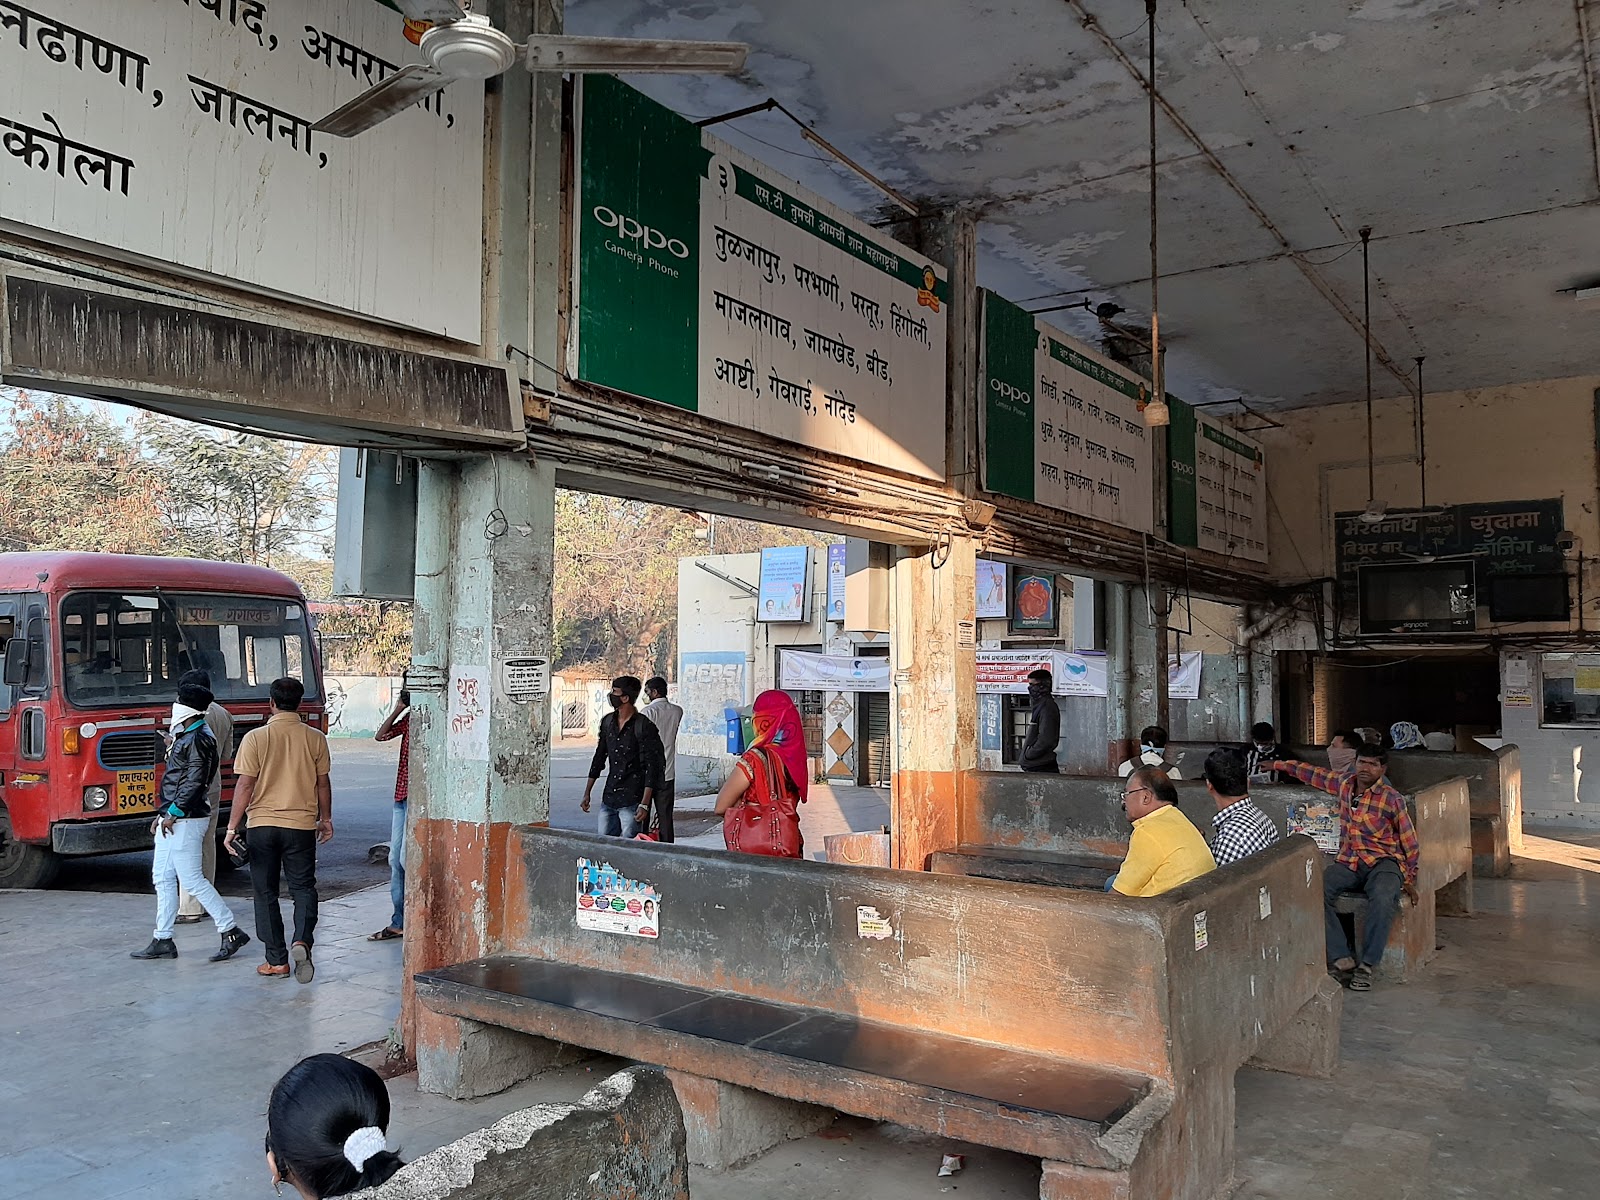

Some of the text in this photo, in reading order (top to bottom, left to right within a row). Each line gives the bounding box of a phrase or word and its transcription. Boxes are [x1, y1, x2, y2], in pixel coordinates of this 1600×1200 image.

[187, 73, 328, 168] जालना,
[717, 164, 730, 192] ३
[593, 205, 689, 259] oppo
[791, 204, 814, 227] तुमची
[819, 220, 845, 243] आमची
[848, 235, 864, 254] शान
[604, 239, 679, 279] Camera Phone
[714, 225, 932, 349] तुळजापुर, परभणी, परतूर, हिंगोली,
[714, 291, 894, 387] माजलगाव, जामखेड, बीड,
[714, 356, 857, 426] आष्टी, गेवराई, नांदेड
[991, 378, 1031, 404] oppo
[1062, 388, 1085, 416] नाशिक,
[1172, 459, 1194, 475] oppo
[1470, 512, 1541, 538] सुदामा
[683, 664, 743, 684] PEPSI
[119, 792, 155, 809] ३०९६
